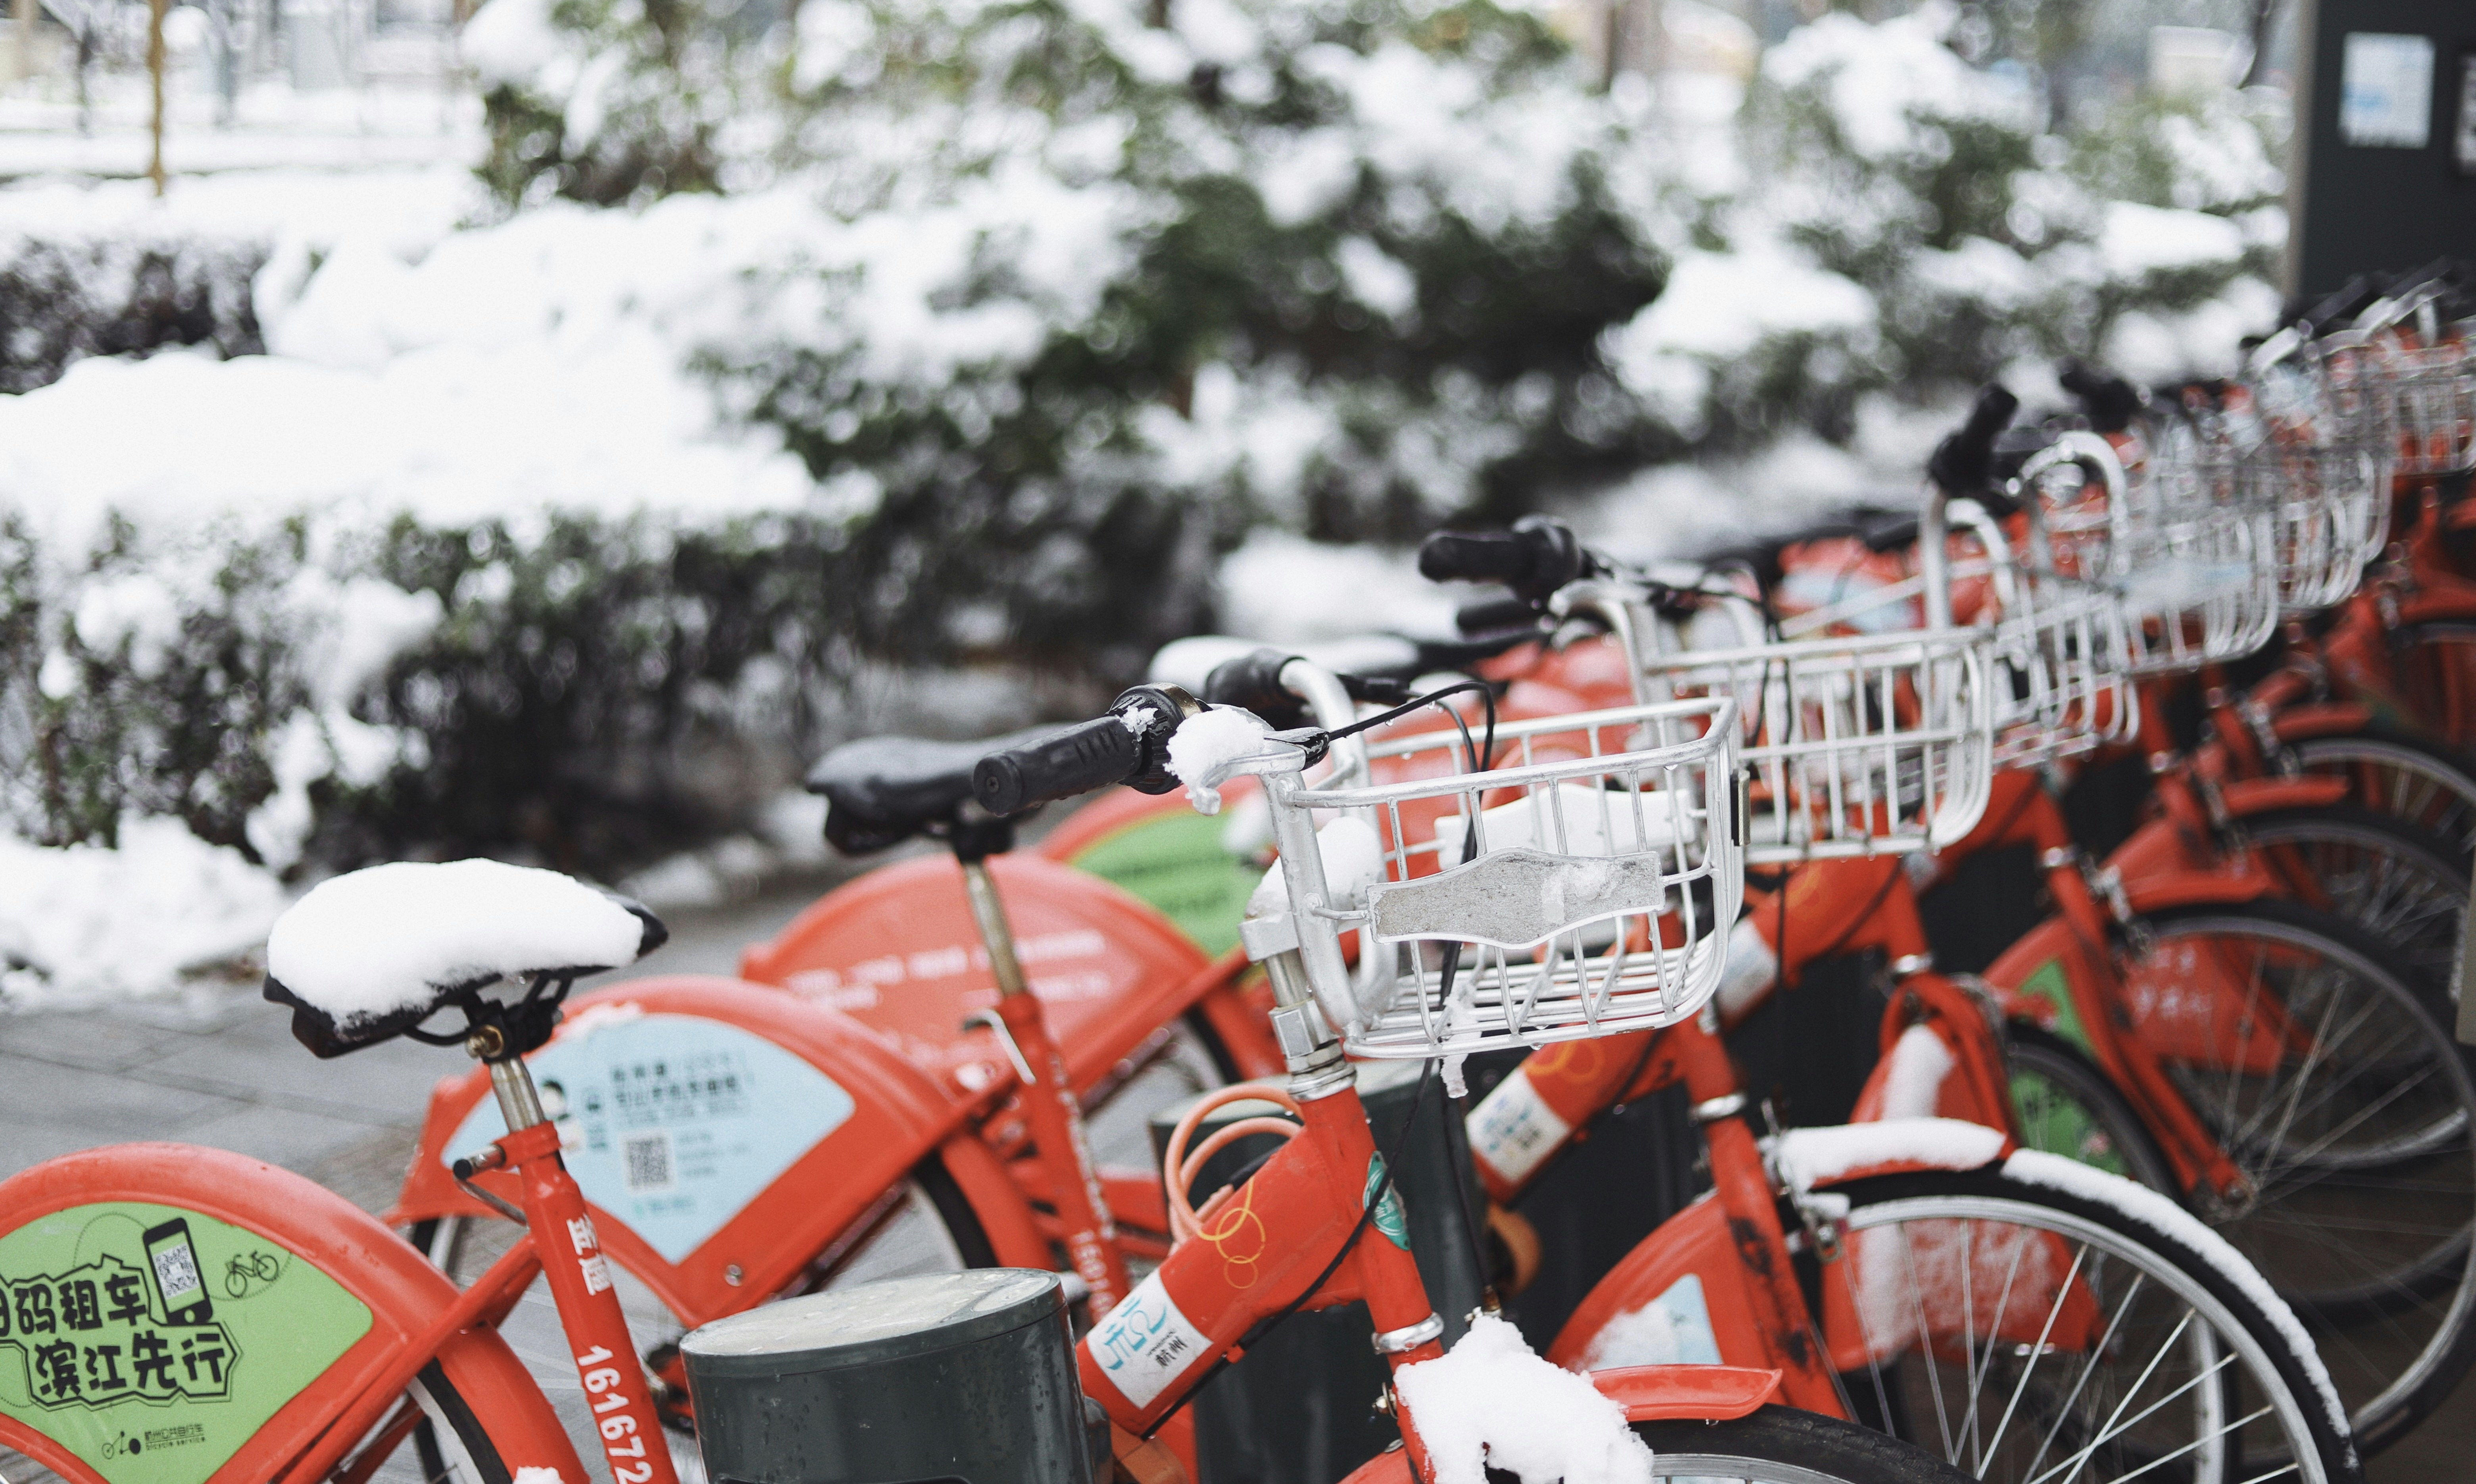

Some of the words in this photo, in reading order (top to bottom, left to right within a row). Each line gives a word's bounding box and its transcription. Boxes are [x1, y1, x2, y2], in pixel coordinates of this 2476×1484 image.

[0, 1273, 146, 1337] 码租车
[34, 1330, 225, 1398] 滨江先行
[577, 1345, 653, 1484] 161672
